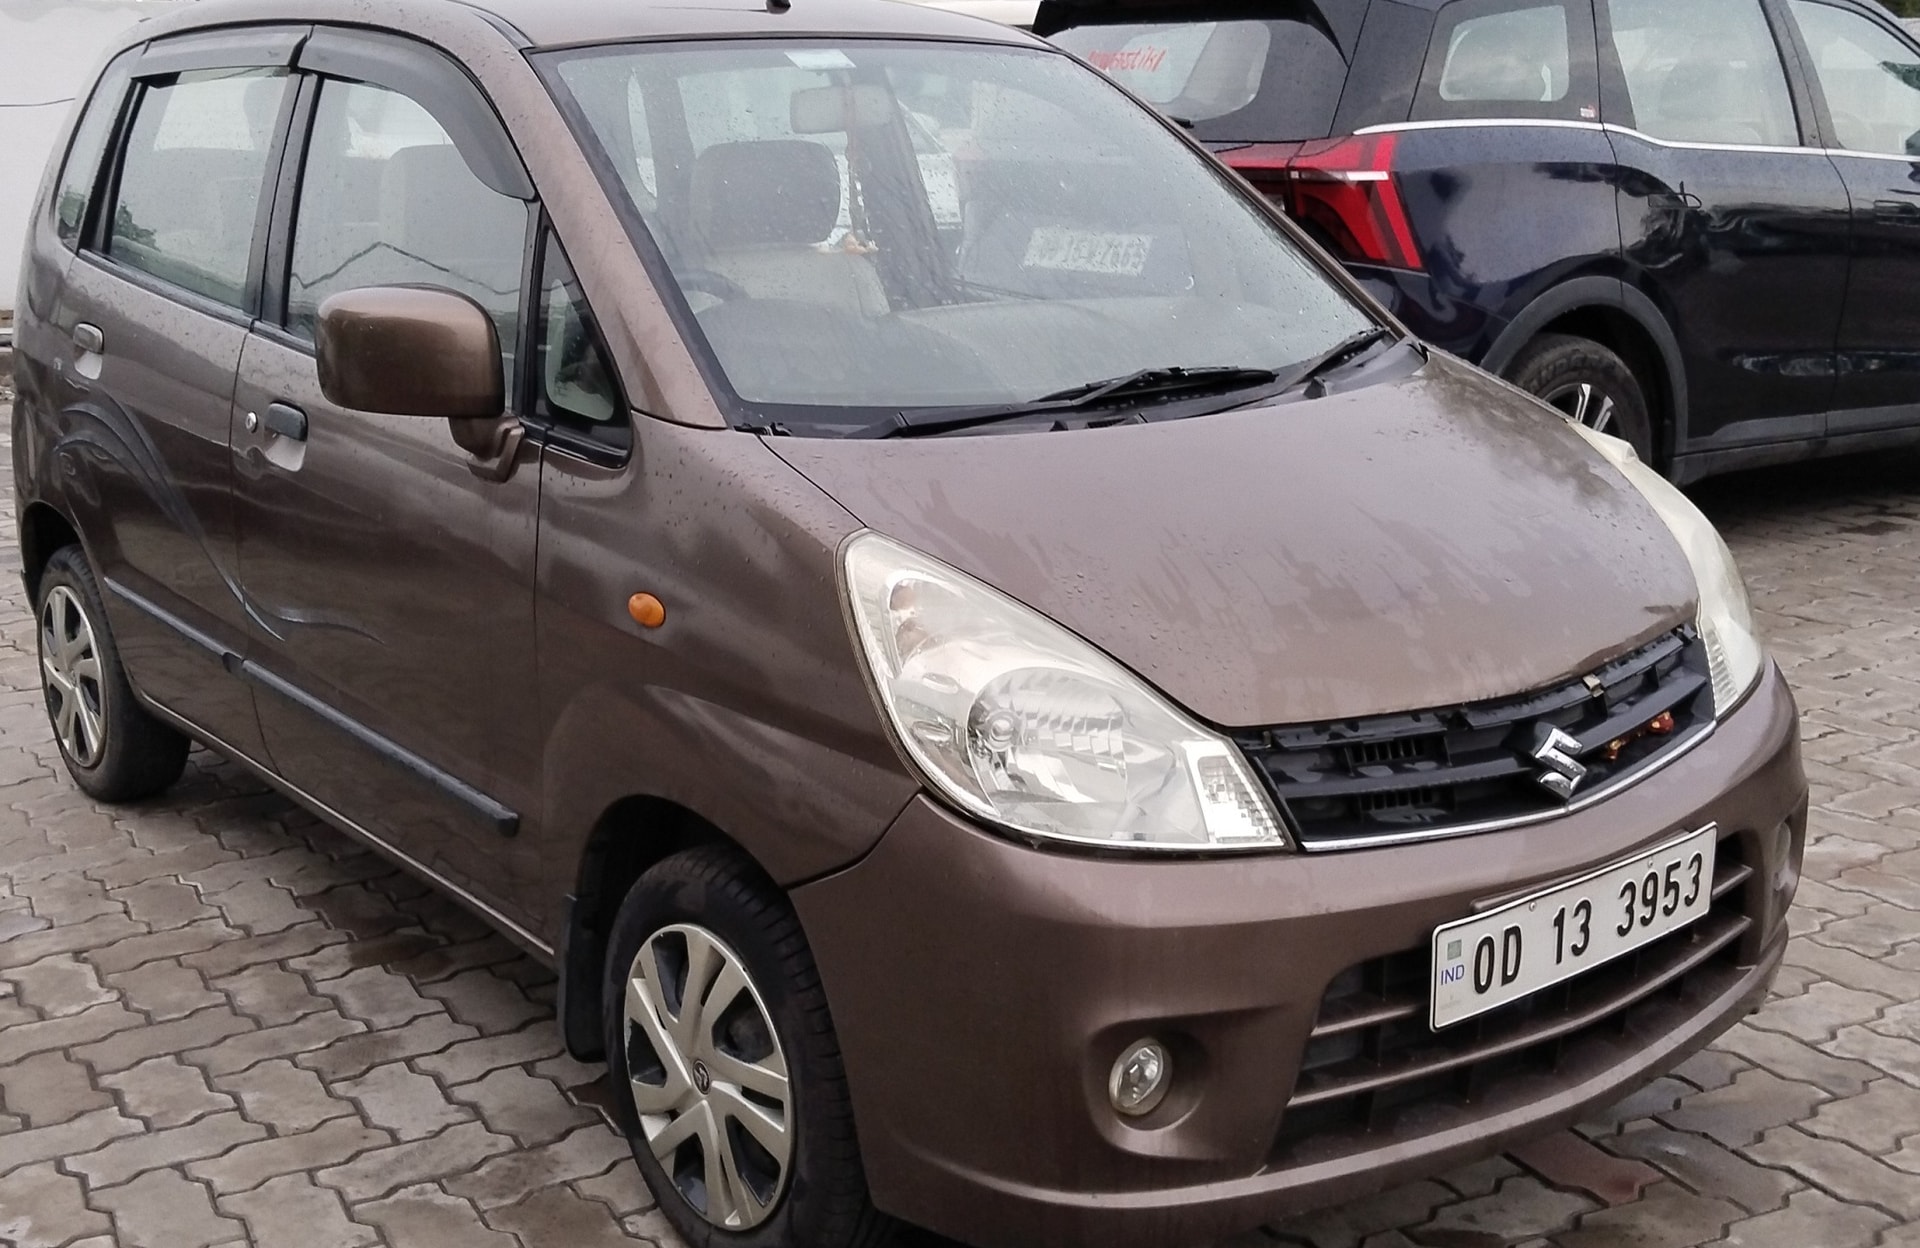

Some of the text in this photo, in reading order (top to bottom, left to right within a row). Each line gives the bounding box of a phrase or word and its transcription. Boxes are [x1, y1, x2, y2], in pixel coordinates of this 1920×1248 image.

[1473, 853, 1702, 994] OD 13 3953
[1440, 965, 1465, 985] IND
